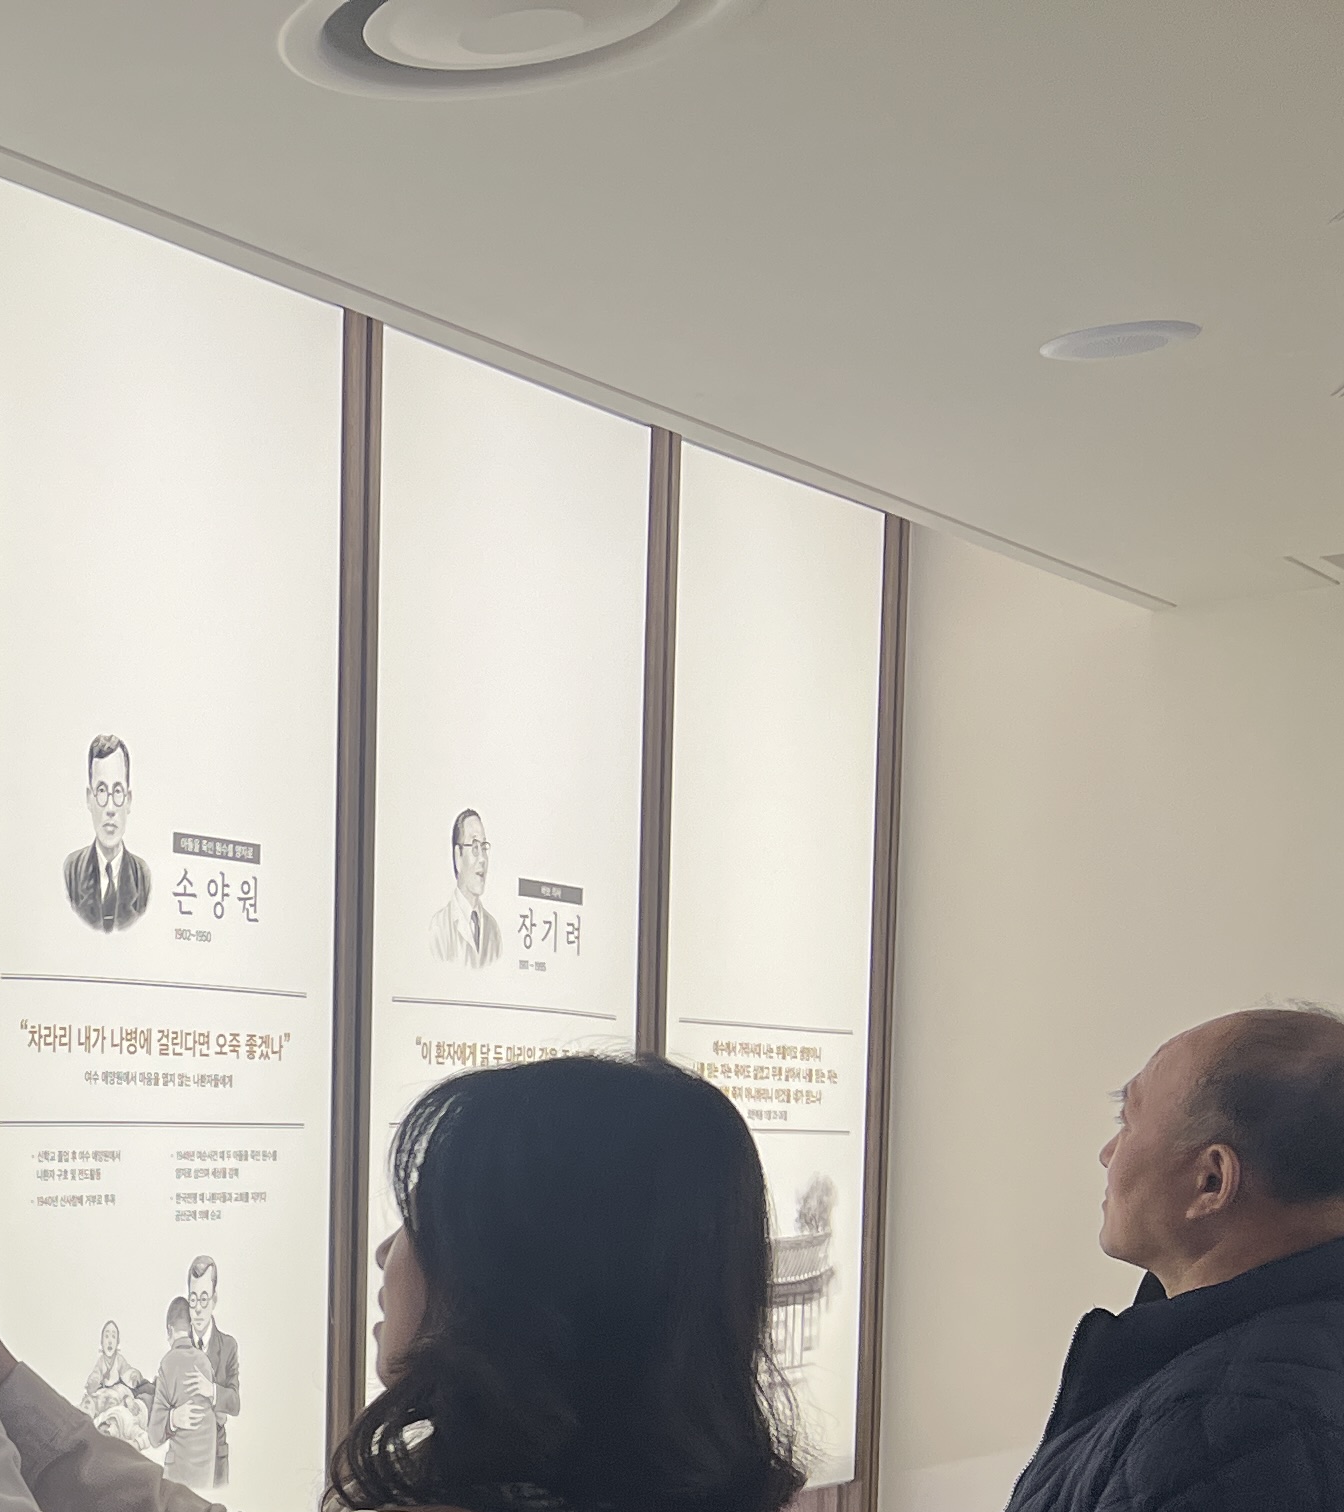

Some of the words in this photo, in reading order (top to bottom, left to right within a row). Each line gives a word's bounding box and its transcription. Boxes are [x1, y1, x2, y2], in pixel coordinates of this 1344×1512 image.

[20, 1019, 72, 1053] “차라리
[77, 1026, 106, 1054] 내가
[110, 1026, 152, 1056] 나병에
[156, 1028, 211, 1058] 걸린다면
[215, 1032, 241, 1059] 오죽
[435, 1041, 477, 1067] 환자에게
